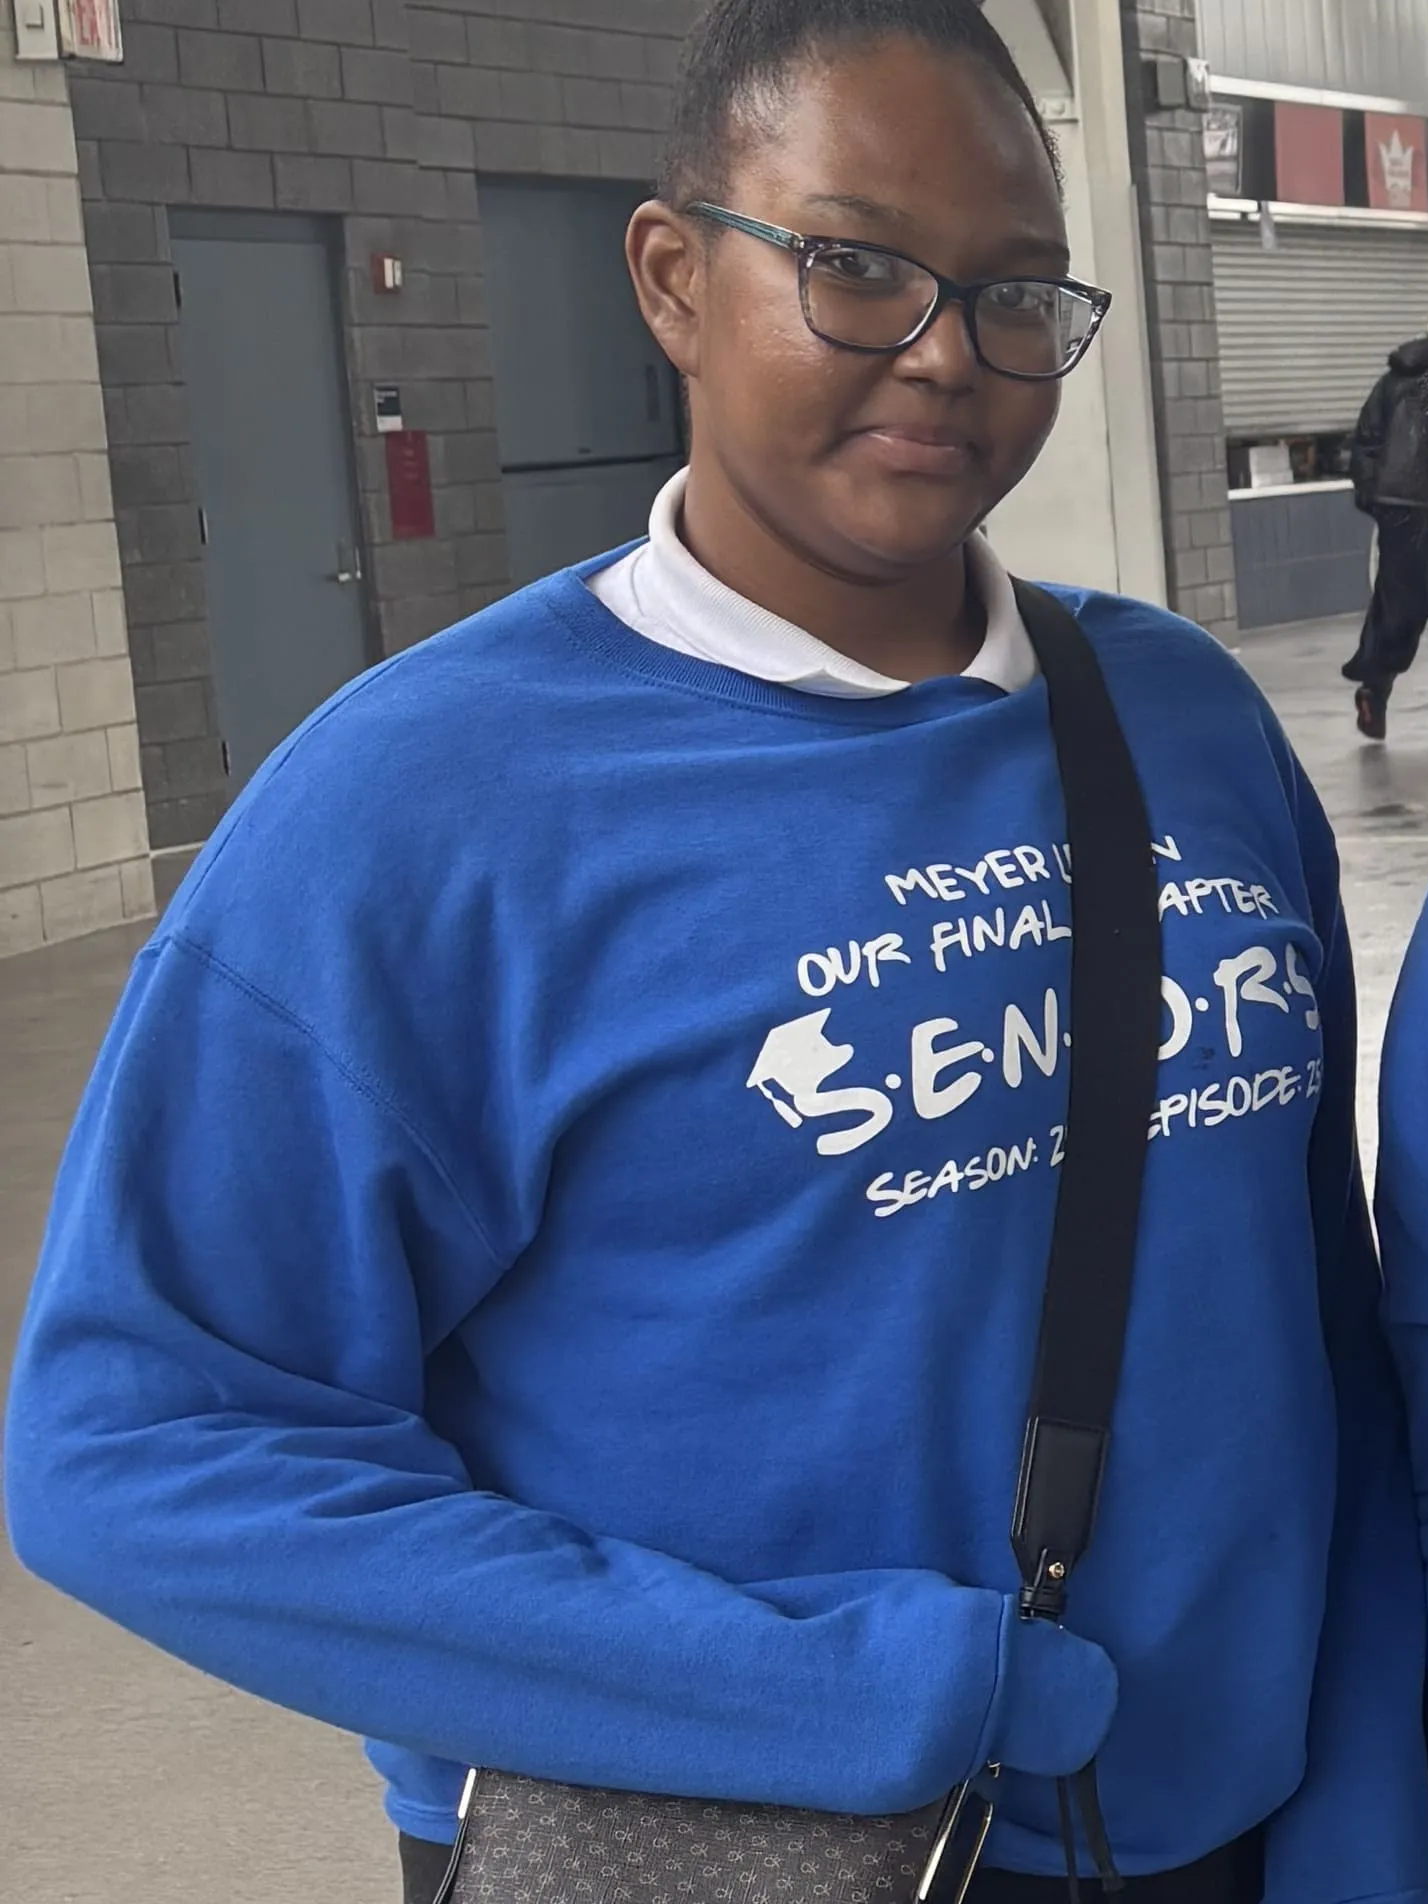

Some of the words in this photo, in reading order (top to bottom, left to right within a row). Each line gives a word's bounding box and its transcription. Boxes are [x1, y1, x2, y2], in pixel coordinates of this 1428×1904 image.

[884, 845, 1051, 905] MEYER
[797, 933, 912, 997] OUR
[929, 900, 1072, 972] FINAL
[1158, 877, 1278, 922] APTER
[865, 1137, 1038, 1218] SEASON:
